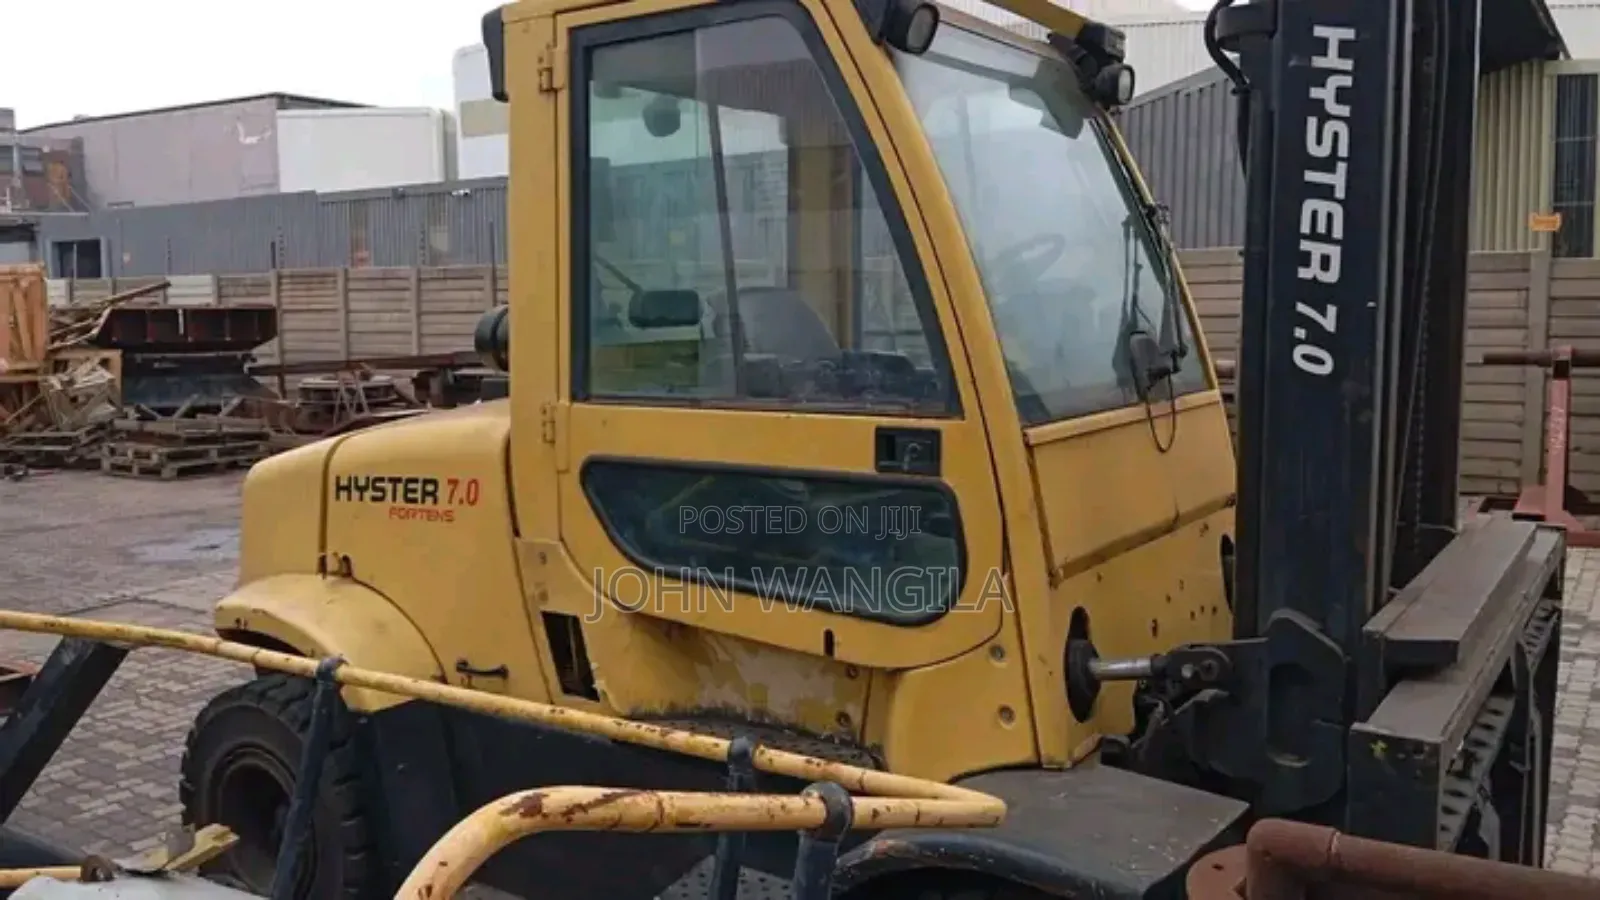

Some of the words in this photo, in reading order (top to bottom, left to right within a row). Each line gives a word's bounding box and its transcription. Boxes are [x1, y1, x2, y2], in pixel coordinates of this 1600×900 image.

[1297, 24, 1356, 284] HYSTER
[1292, 301, 1338, 376] 7.0
[335, 475, 439, 505] HYSTER
[447, 478, 479, 506] 7.0
[388, 507, 455, 523] FORTENS
